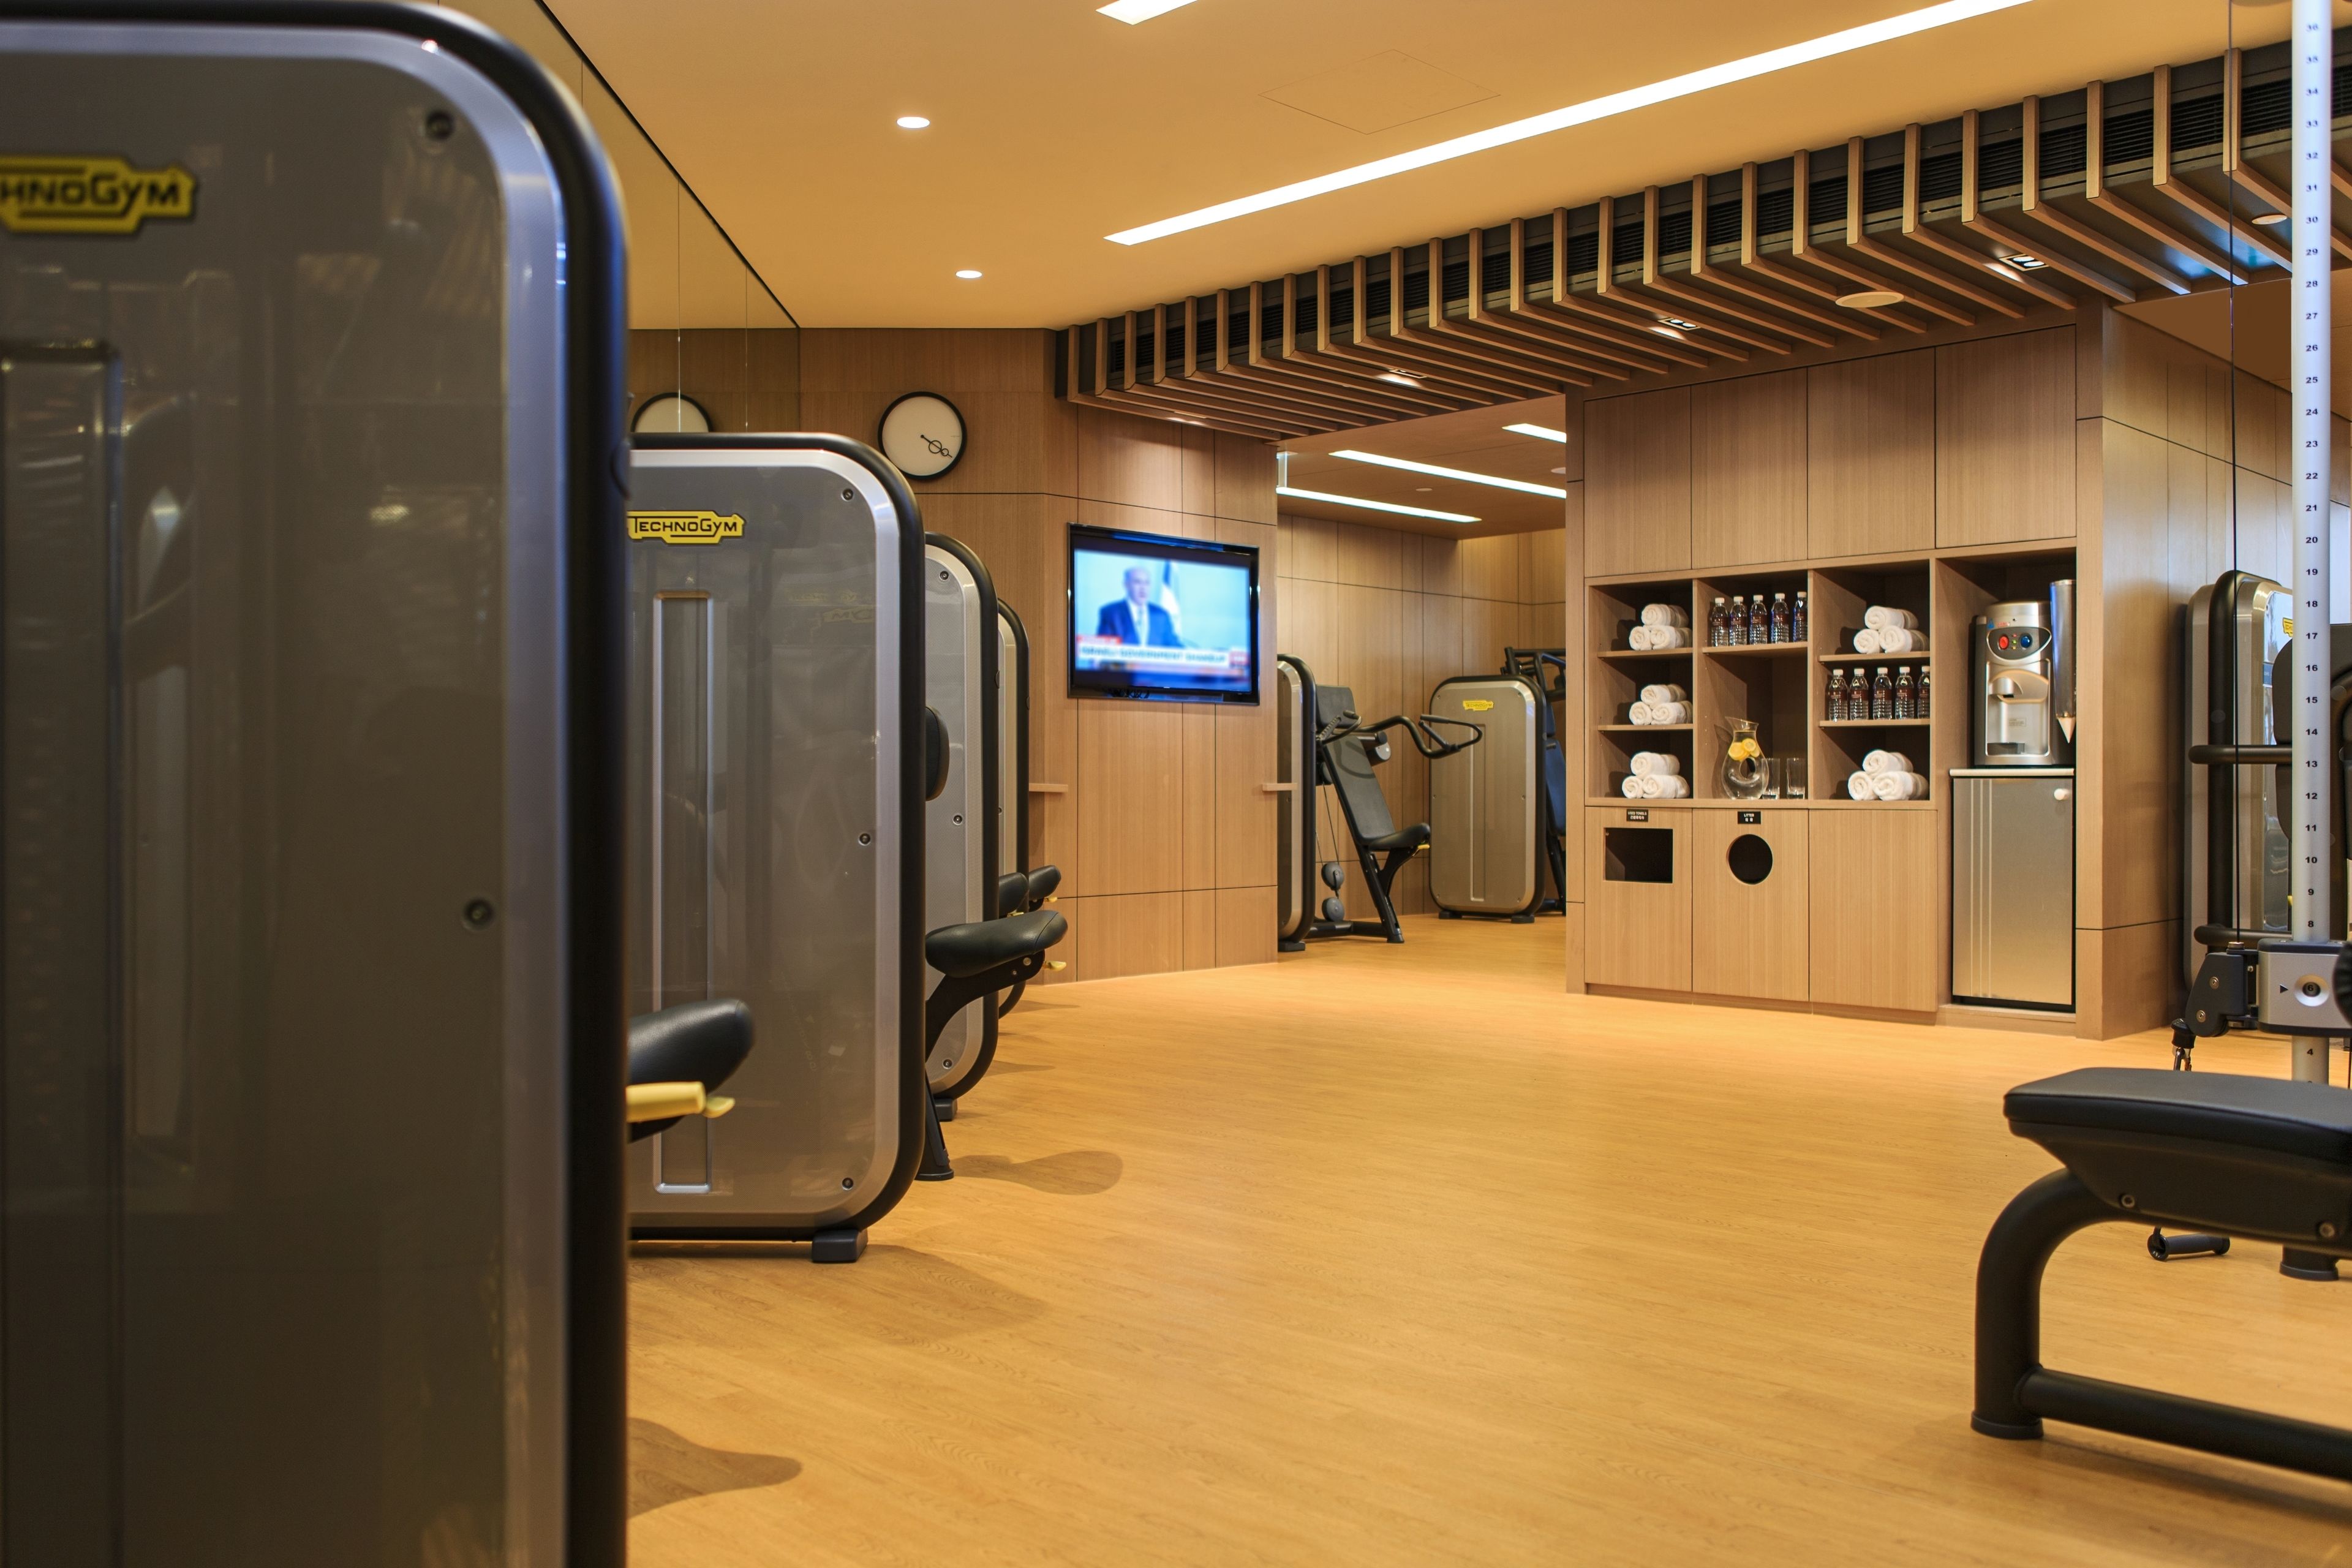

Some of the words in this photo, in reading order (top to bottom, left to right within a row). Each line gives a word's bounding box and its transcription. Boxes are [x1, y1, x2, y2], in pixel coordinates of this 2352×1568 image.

[2305, 87, 2319, 96] 34
[2305, 119, 2319, 129] 33
[2305, 151, 2318, 160] 32
[2305, 183, 2318, 192] 31
[2305, 215, 2319, 224] 30
[2305, 247, 2318, 257] 29
[2305, 279, 2318, 288] 28
[2305, 312, 2318, 320] 27
[2305, 344, 2318, 352] 26
[2305, 375, 2318, 385] 25
[2305, 407, 2319, 417] 24
[2305, 440, 2318, 448] 23
[2305, 472, 2318, 480] 22
[2305, 568, 2318, 576] 19
[2305, 600, 2318, 608] 18
[2305, 631, 2318, 640] 17
[2305, 760, 2318, 768] 13
[2305, 824, 2317, 832] 11
[2305, 856, 2318, 864] 10
[2307, 888, 2315, 896] 9
